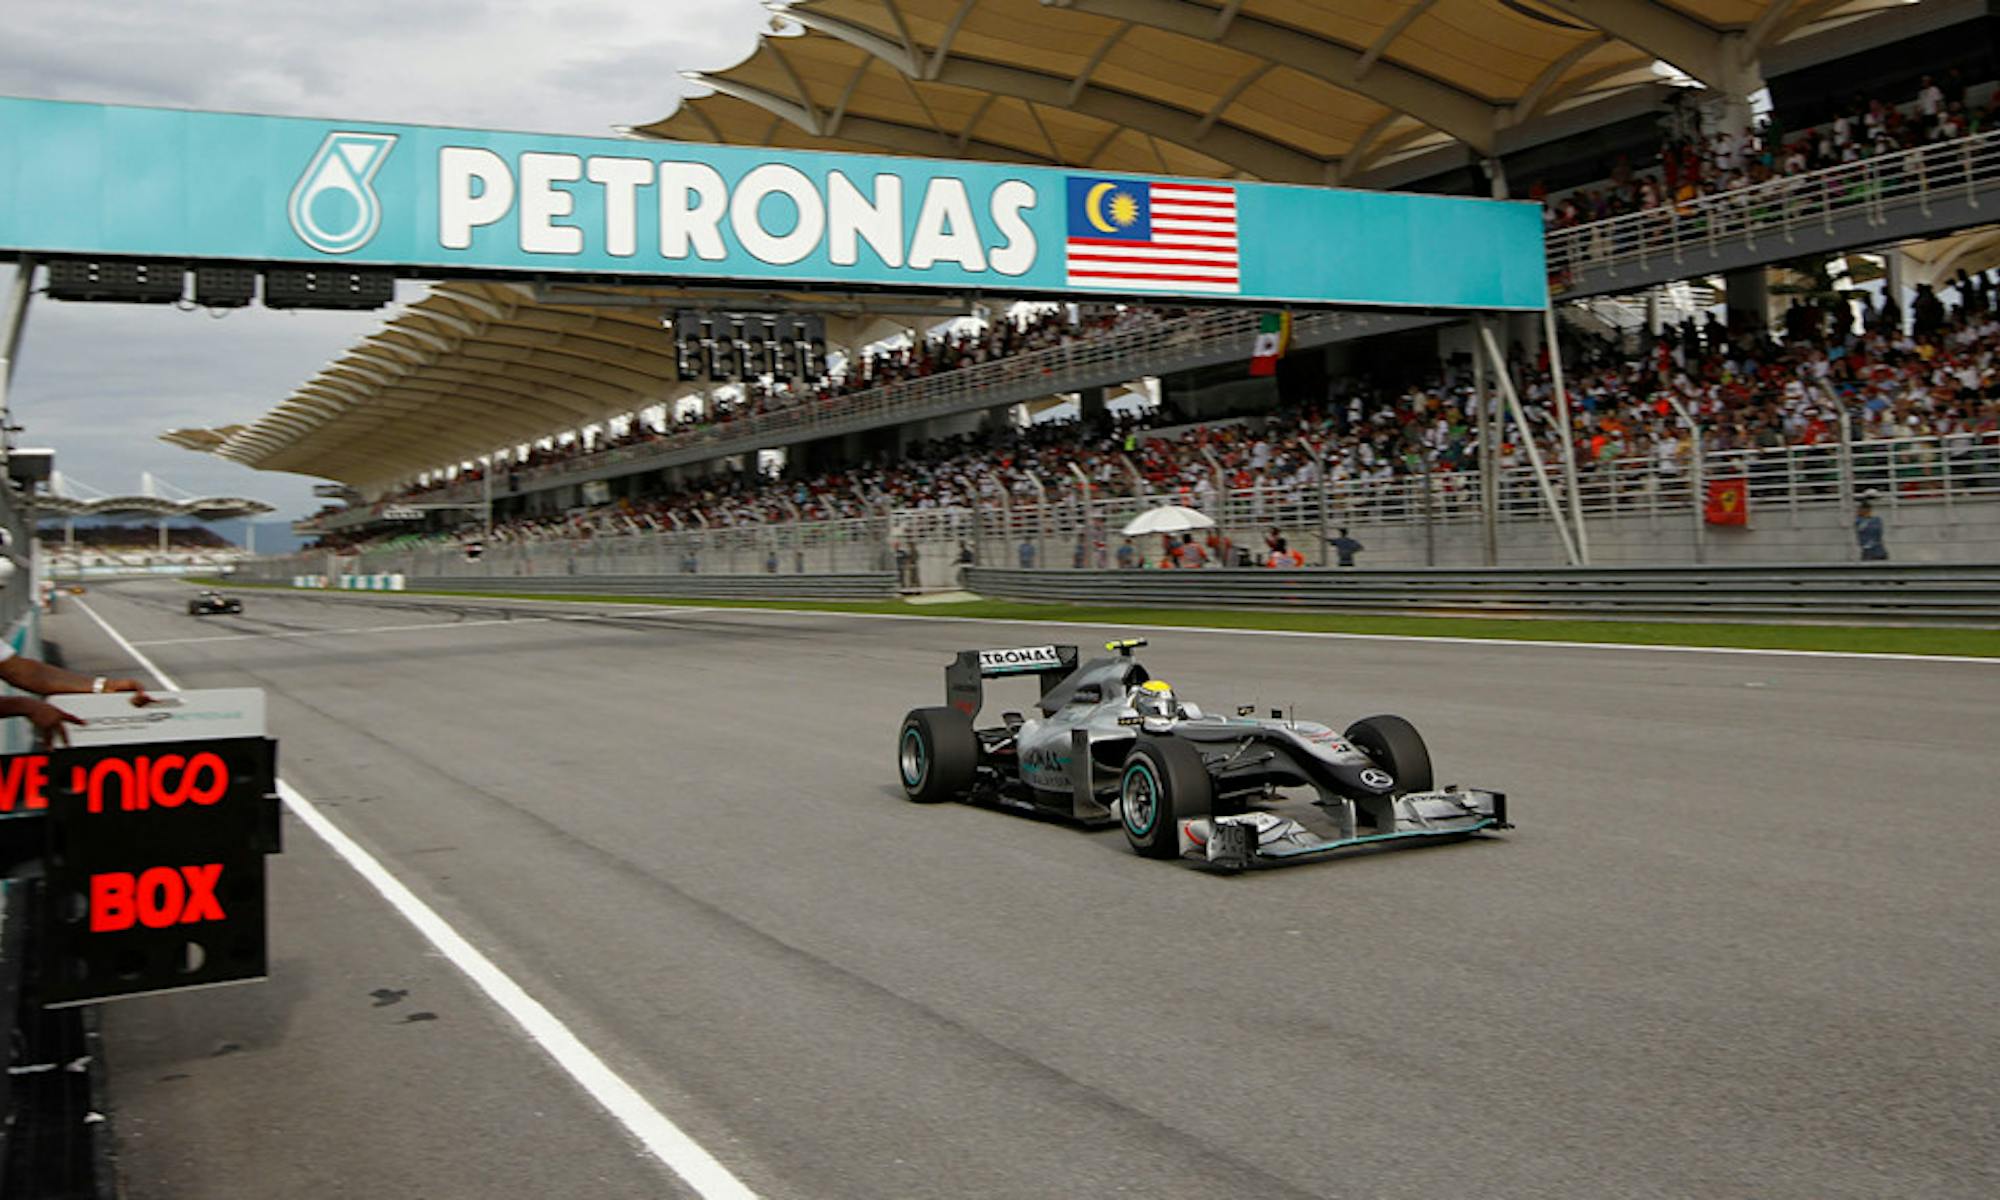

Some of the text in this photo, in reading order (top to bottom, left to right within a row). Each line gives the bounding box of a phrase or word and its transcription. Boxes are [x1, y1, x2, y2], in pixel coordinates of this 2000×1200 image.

[438, 145, 1038, 277] PETRONAS
[979, 648, 1057, 665] TRONAS
[90, 863, 226, 932] BOX
